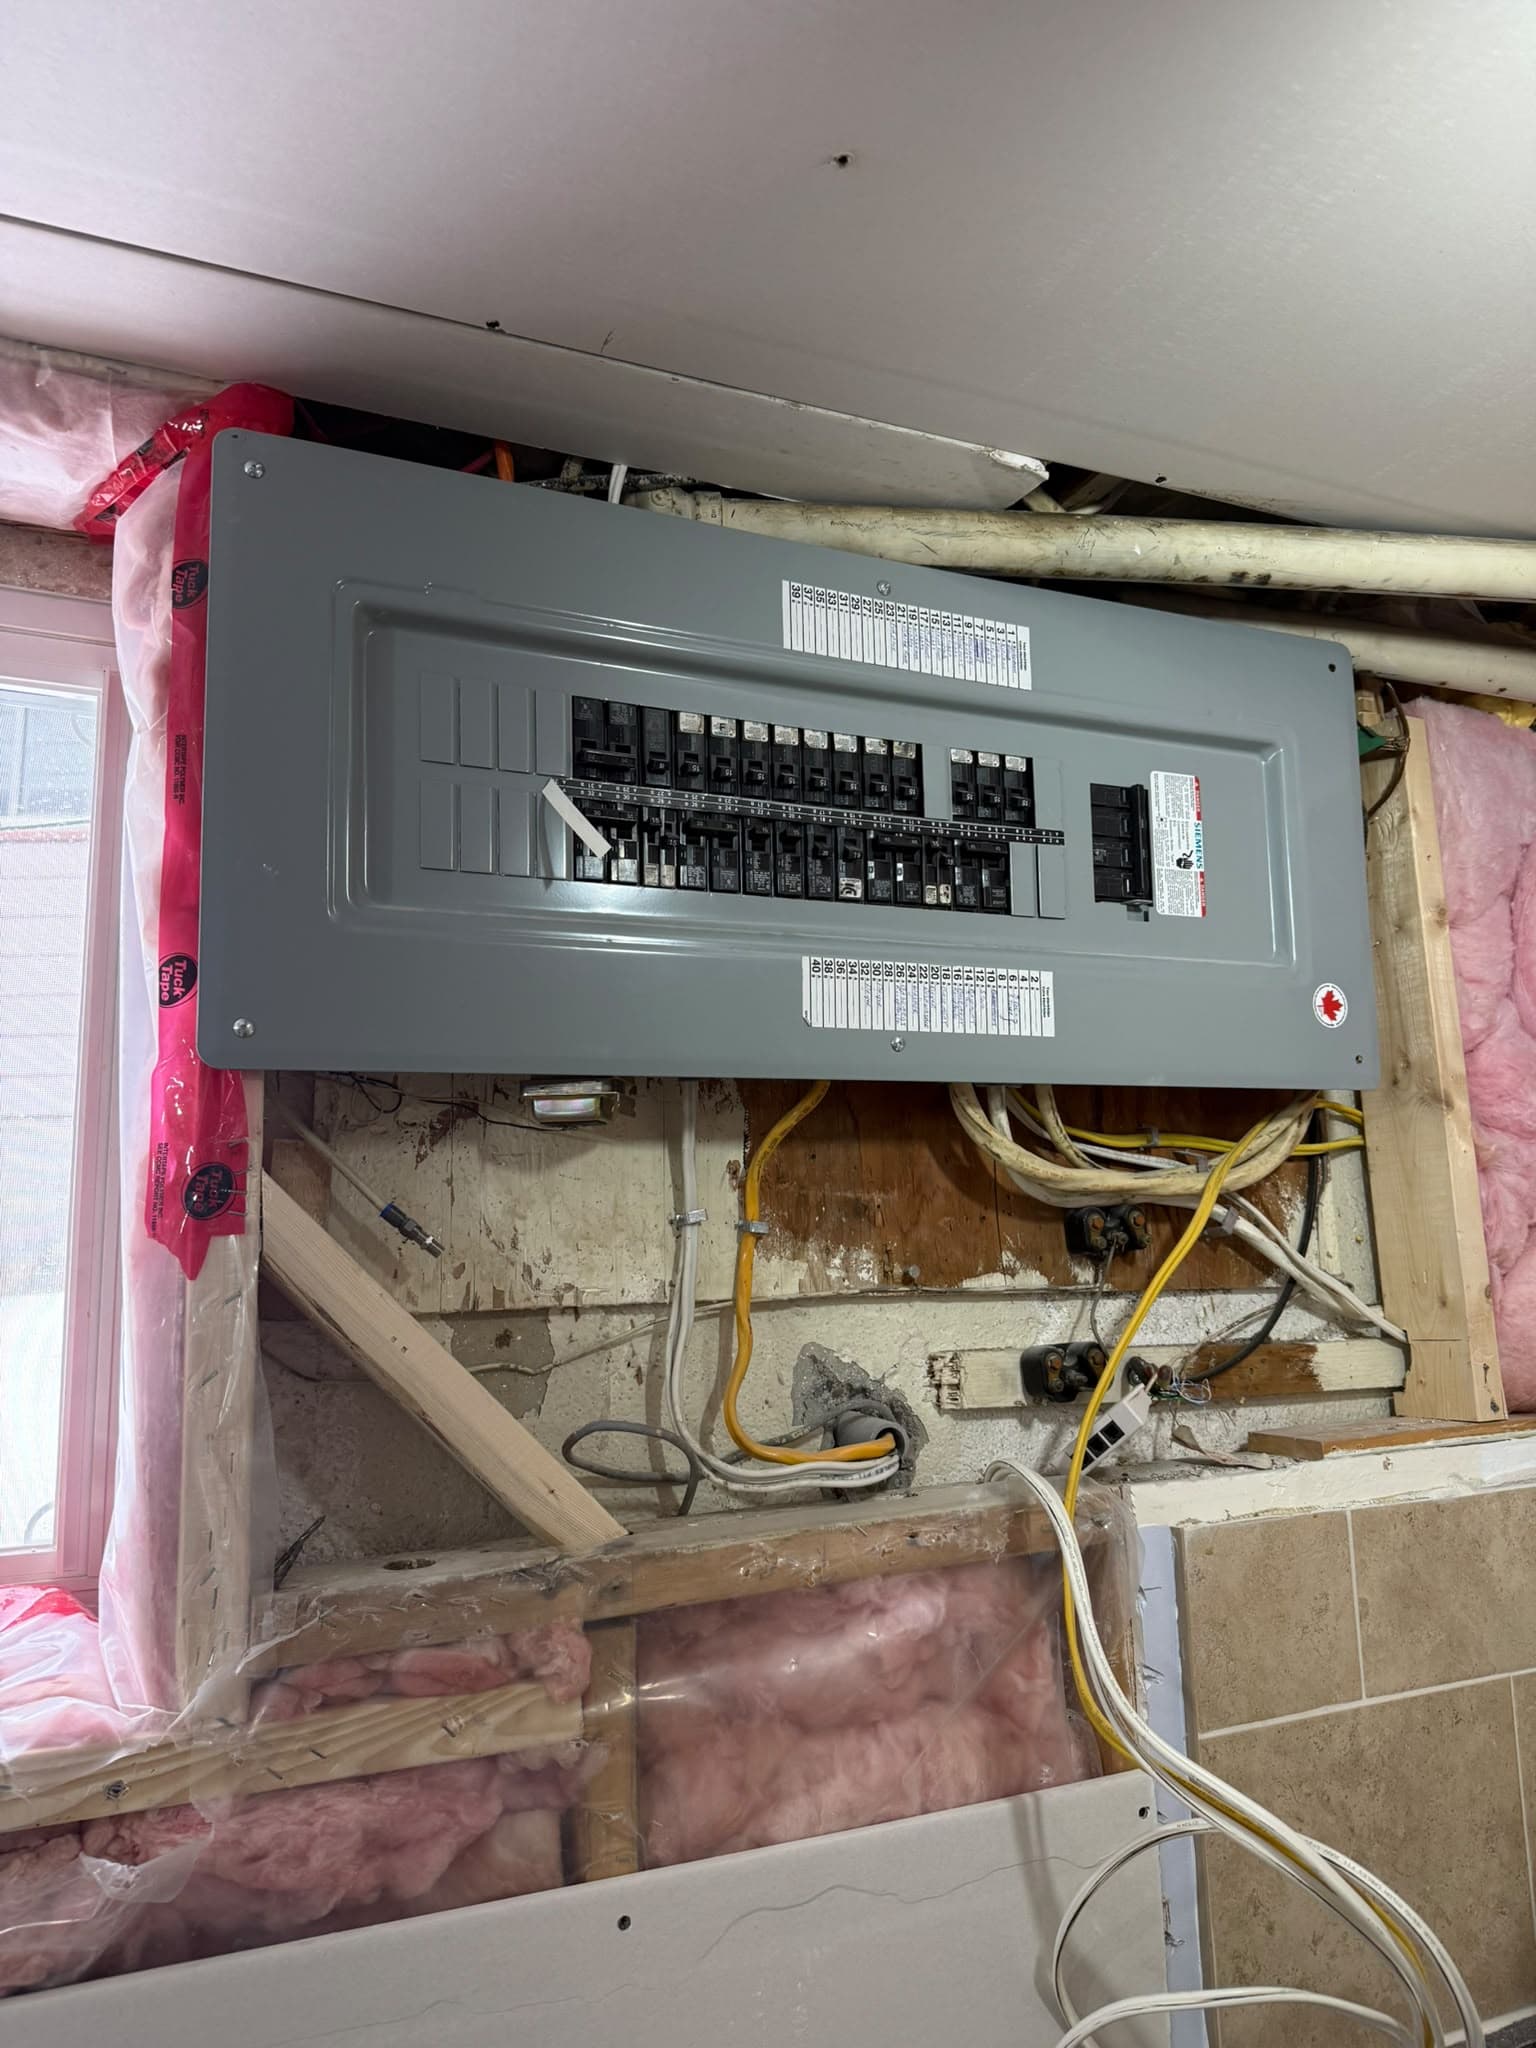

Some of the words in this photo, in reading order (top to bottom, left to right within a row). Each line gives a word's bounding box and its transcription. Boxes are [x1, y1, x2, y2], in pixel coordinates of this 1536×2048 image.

[170, 569, 188, 603] Tape
[186, 564, 200, 600] Tuck
[791, 584, 801, 599] 39
[803, 586, 813, 601] 37
[815, 589, 825, 603] 35
[827, 591, 837, 606] 33
[839, 593, 848, 607] 31
[850, 596, 860, 610] 29
[862, 598, 872, 613] 27
[874, 600, 884, 615] 25
[885, 603, 895, 617] 23
[897, 605, 906, 618] 21
[908, 608, 918, 621] 19
[919, 610, 929, 623] 17
[931, 612, 940, 625] 15
[942, 615, 951, 627] 13
[953, 617, 962, 628] 11
[1194, 821, 1203, 870] SIEMENS
[811, 958, 821, 973] 40
[823, 959, 834, 974] 38
[835, 960, 846, 974] 36
[847, 960, 858, 975] 34
[860, 961, 870, 976] 32
[871, 962, 882, 976] 30
[883, 963, 894, 977] 28
[895, 964, 905, 978] 26
[907, 964, 917, 978] 24
[918, 965, 928, 979] 22
[930, 965, 940, 980] 20
[172, 959, 188, 999] Tuck
[942, 967, 951, 980] 18
[953, 968, 962, 981] 16
[964, 968, 973, 981] 14
[975, 969, 985, 982] 12
[986, 969, 996, 983] 10
[159, 964, 173, 1002] Tape
[192, 1174, 209, 1213] Tape
[207, 1170, 223, 1209] Tuck
